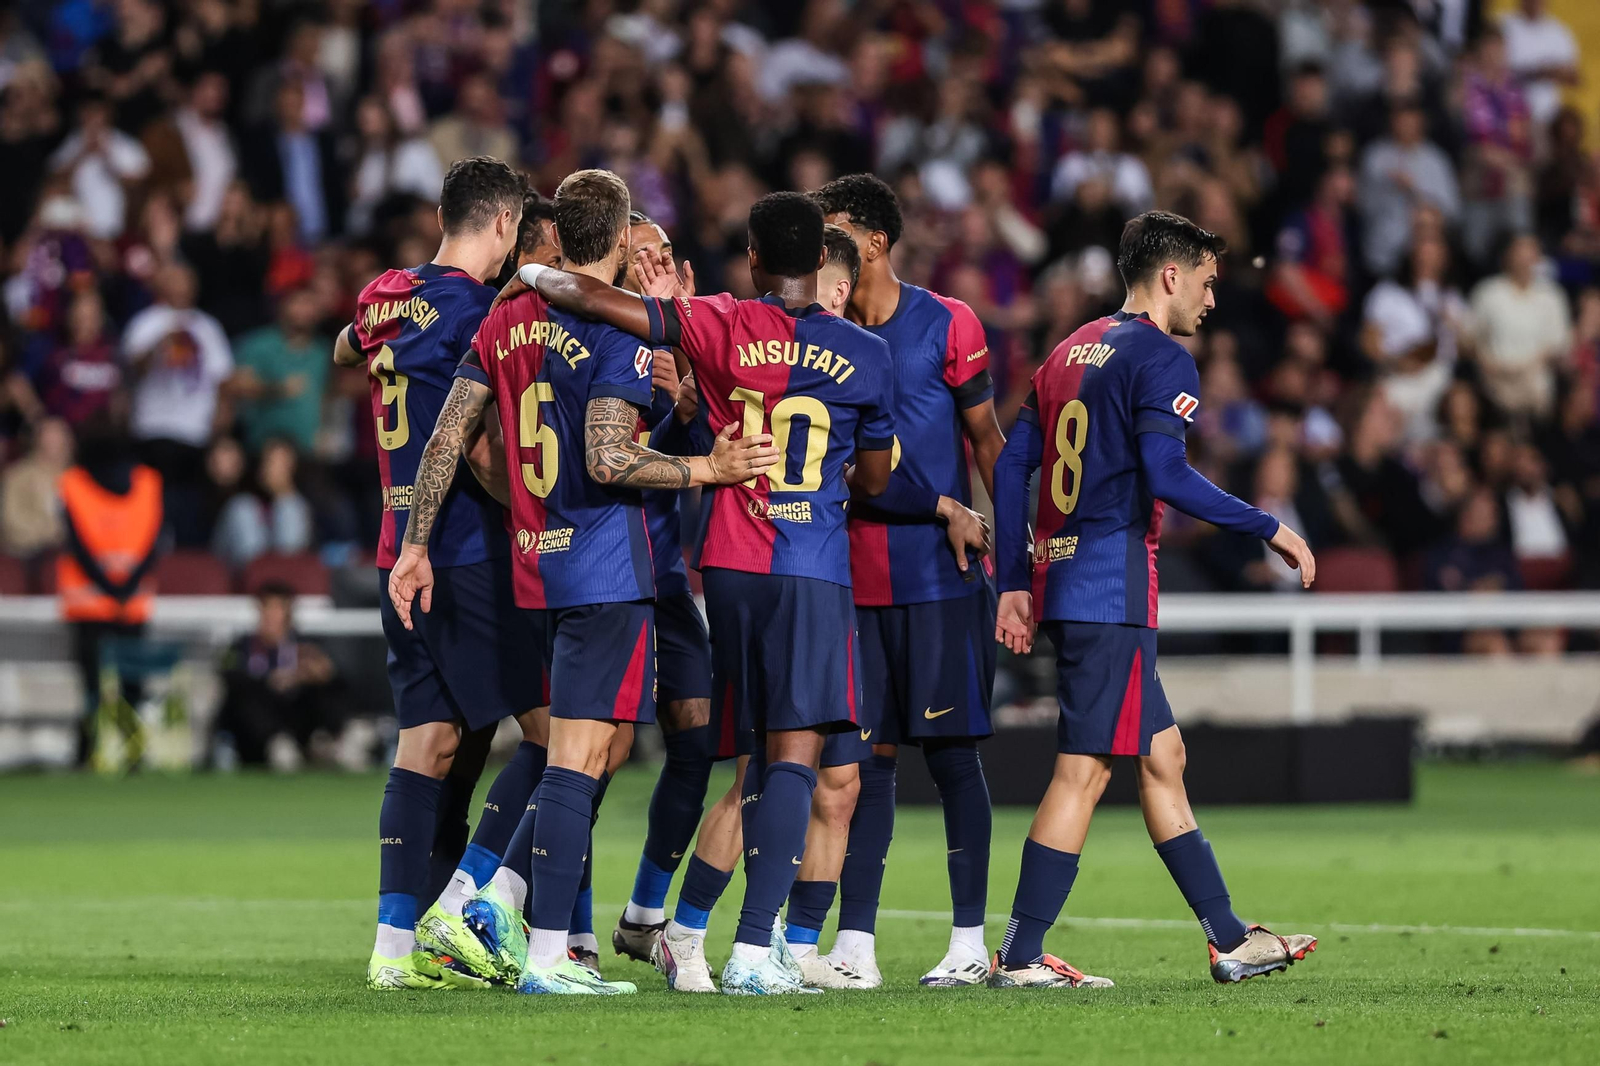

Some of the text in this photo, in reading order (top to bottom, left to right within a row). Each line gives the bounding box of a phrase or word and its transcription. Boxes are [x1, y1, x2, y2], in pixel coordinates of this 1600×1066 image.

[736, 340, 856, 385] ANSU FATI
[1065, 343, 1117, 369] PEDRI
[370, 343, 409, 451] 9
[519, 382, 559, 498] 5
[728, 386, 831, 493] 10
[1051, 399, 1088, 515] 8
[390, 485, 414, 496] UNHC
[391, 495, 413, 506] ACNU
[536, 536, 571, 550] ACNUR
[538, 528, 574, 541] UNHCR
[1047, 535, 1079, 548] UNHCR
